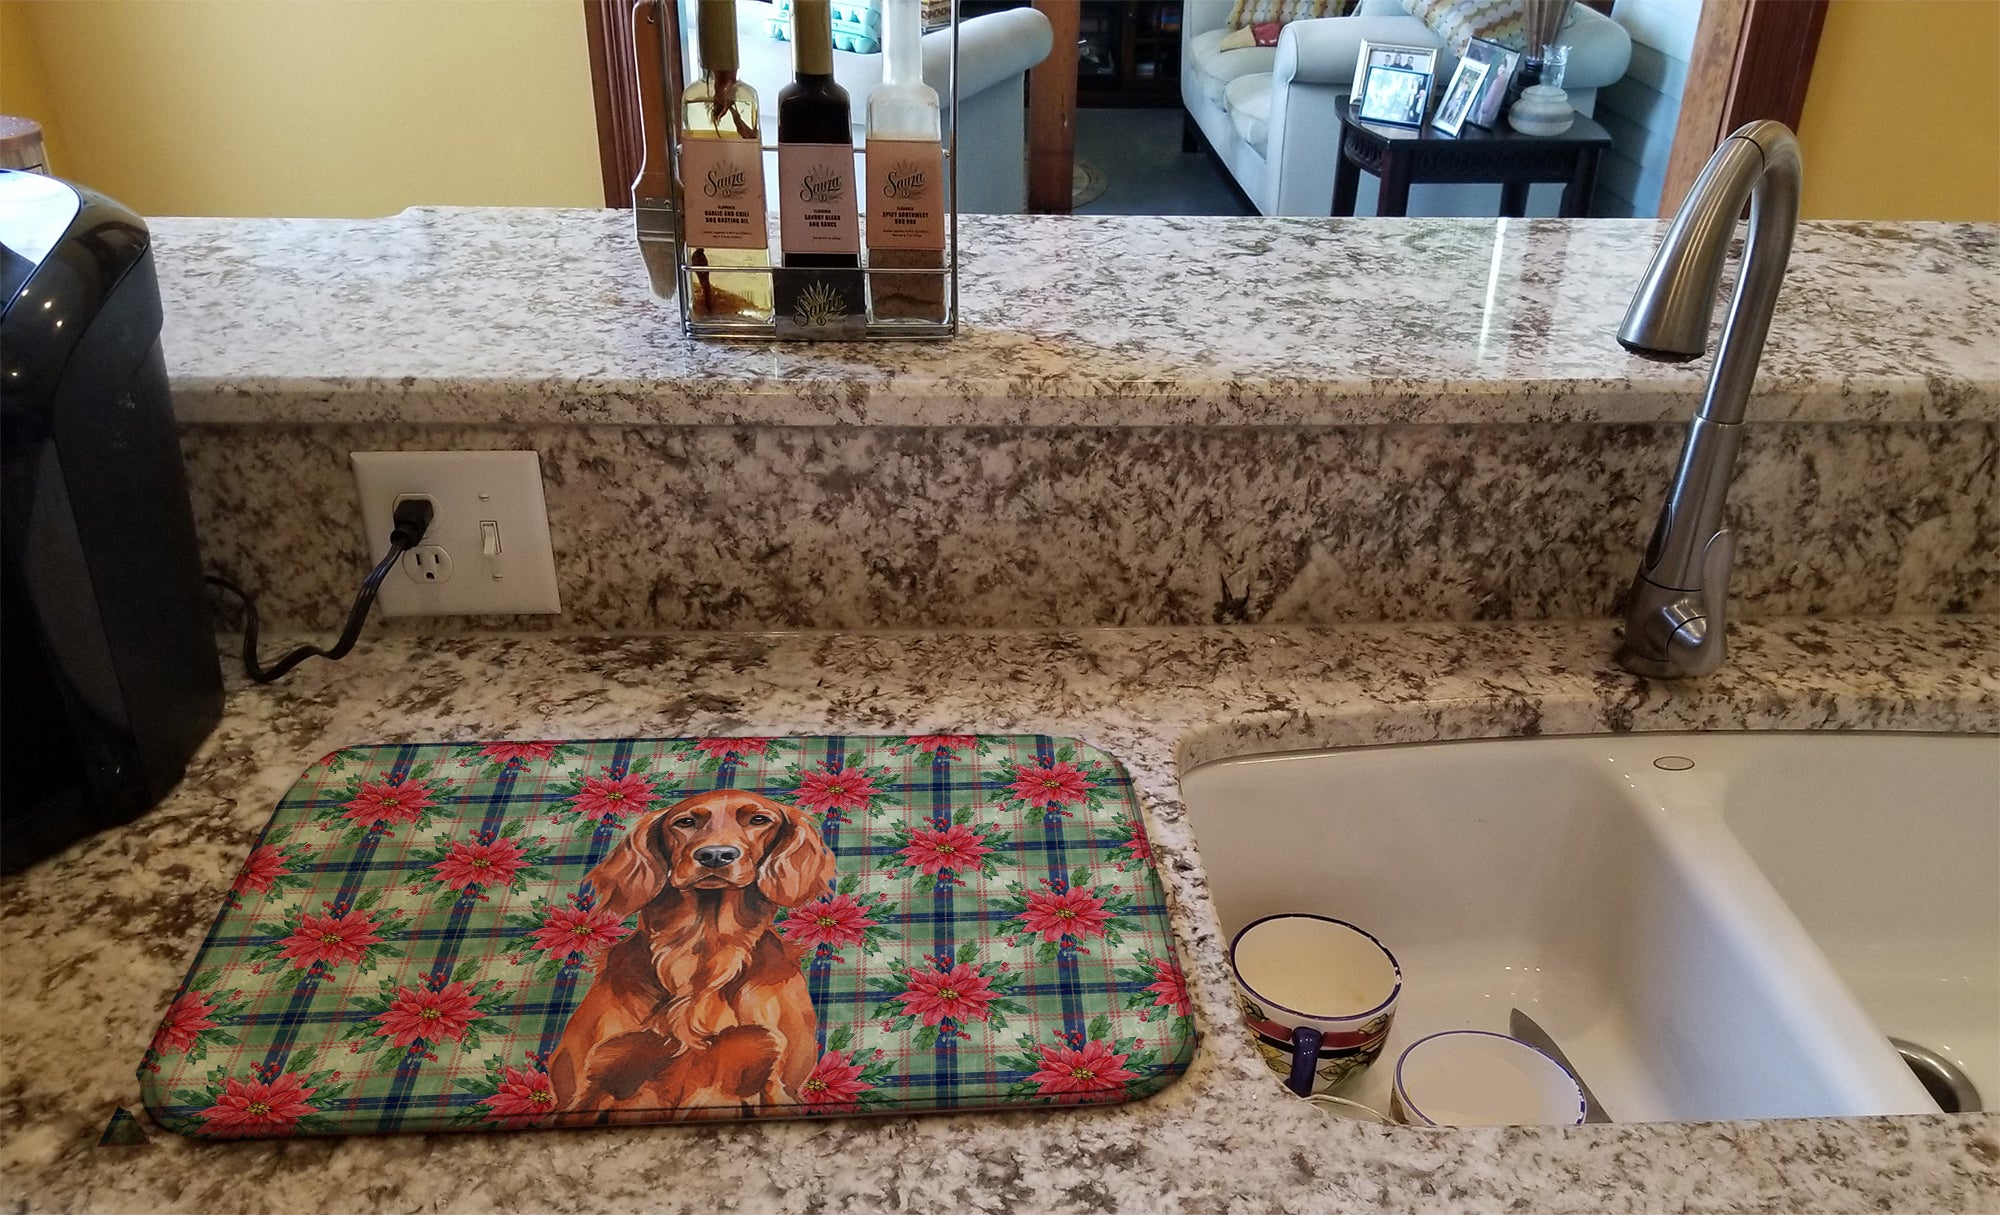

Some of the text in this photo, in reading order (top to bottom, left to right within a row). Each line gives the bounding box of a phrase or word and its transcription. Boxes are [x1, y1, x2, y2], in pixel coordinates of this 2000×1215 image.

[703, 170, 745, 197] Sauza
[800, 175, 841, 202] Sauza
[883, 171, 925, 198] Sauza
